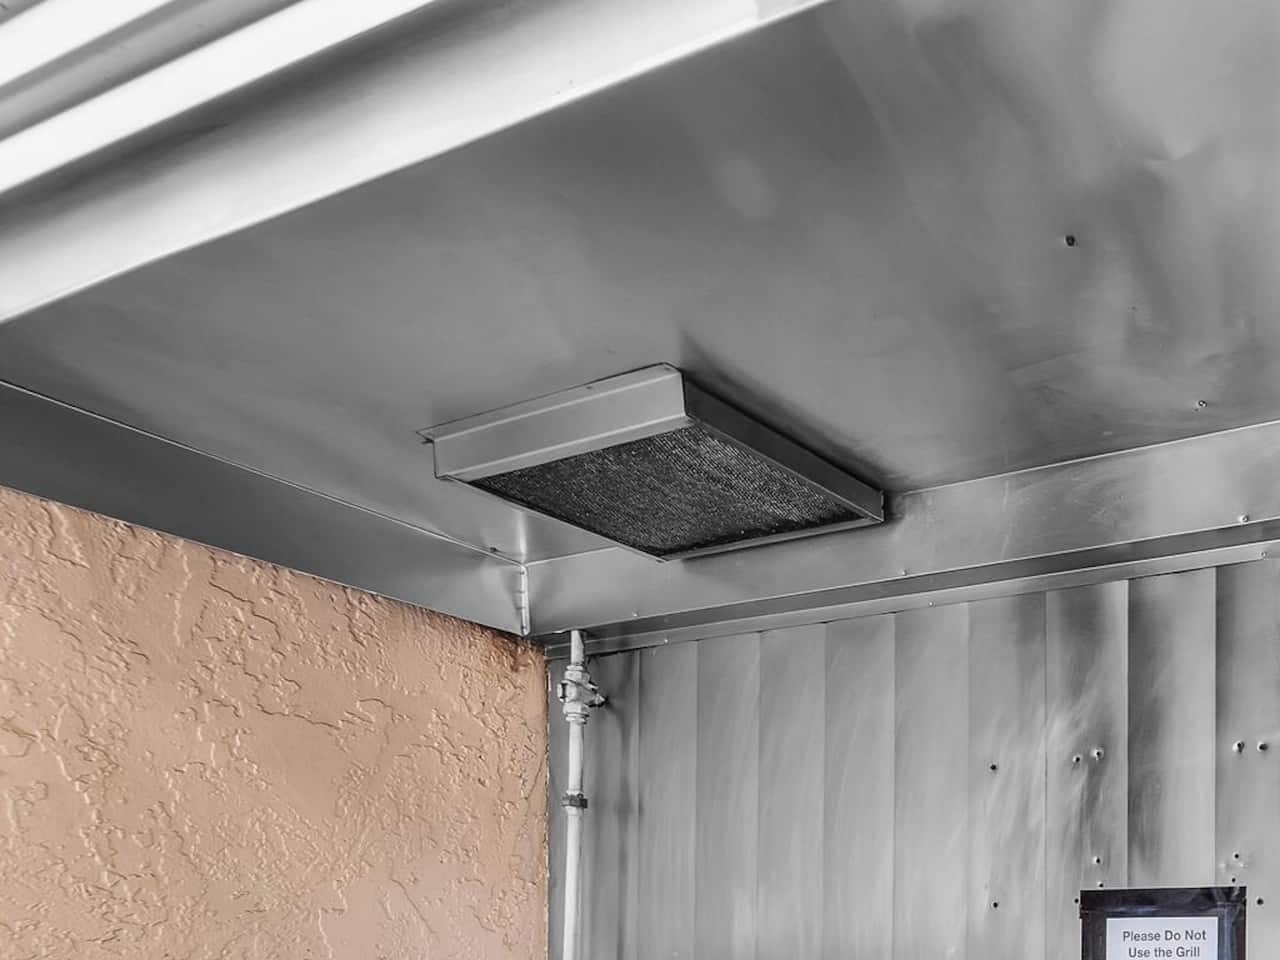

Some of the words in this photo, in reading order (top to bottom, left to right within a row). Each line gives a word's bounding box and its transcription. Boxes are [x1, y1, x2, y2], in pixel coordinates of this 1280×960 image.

[1123, 931, 1161, 941] Please
[1164, 930, 1180, 940] Do
[1185, 930, 1207, 940] Not
[1129, 947, 1150, 958] Use
[1155, 947, 1172, 957] the
[1176, 947, 1200, 957] Grill
